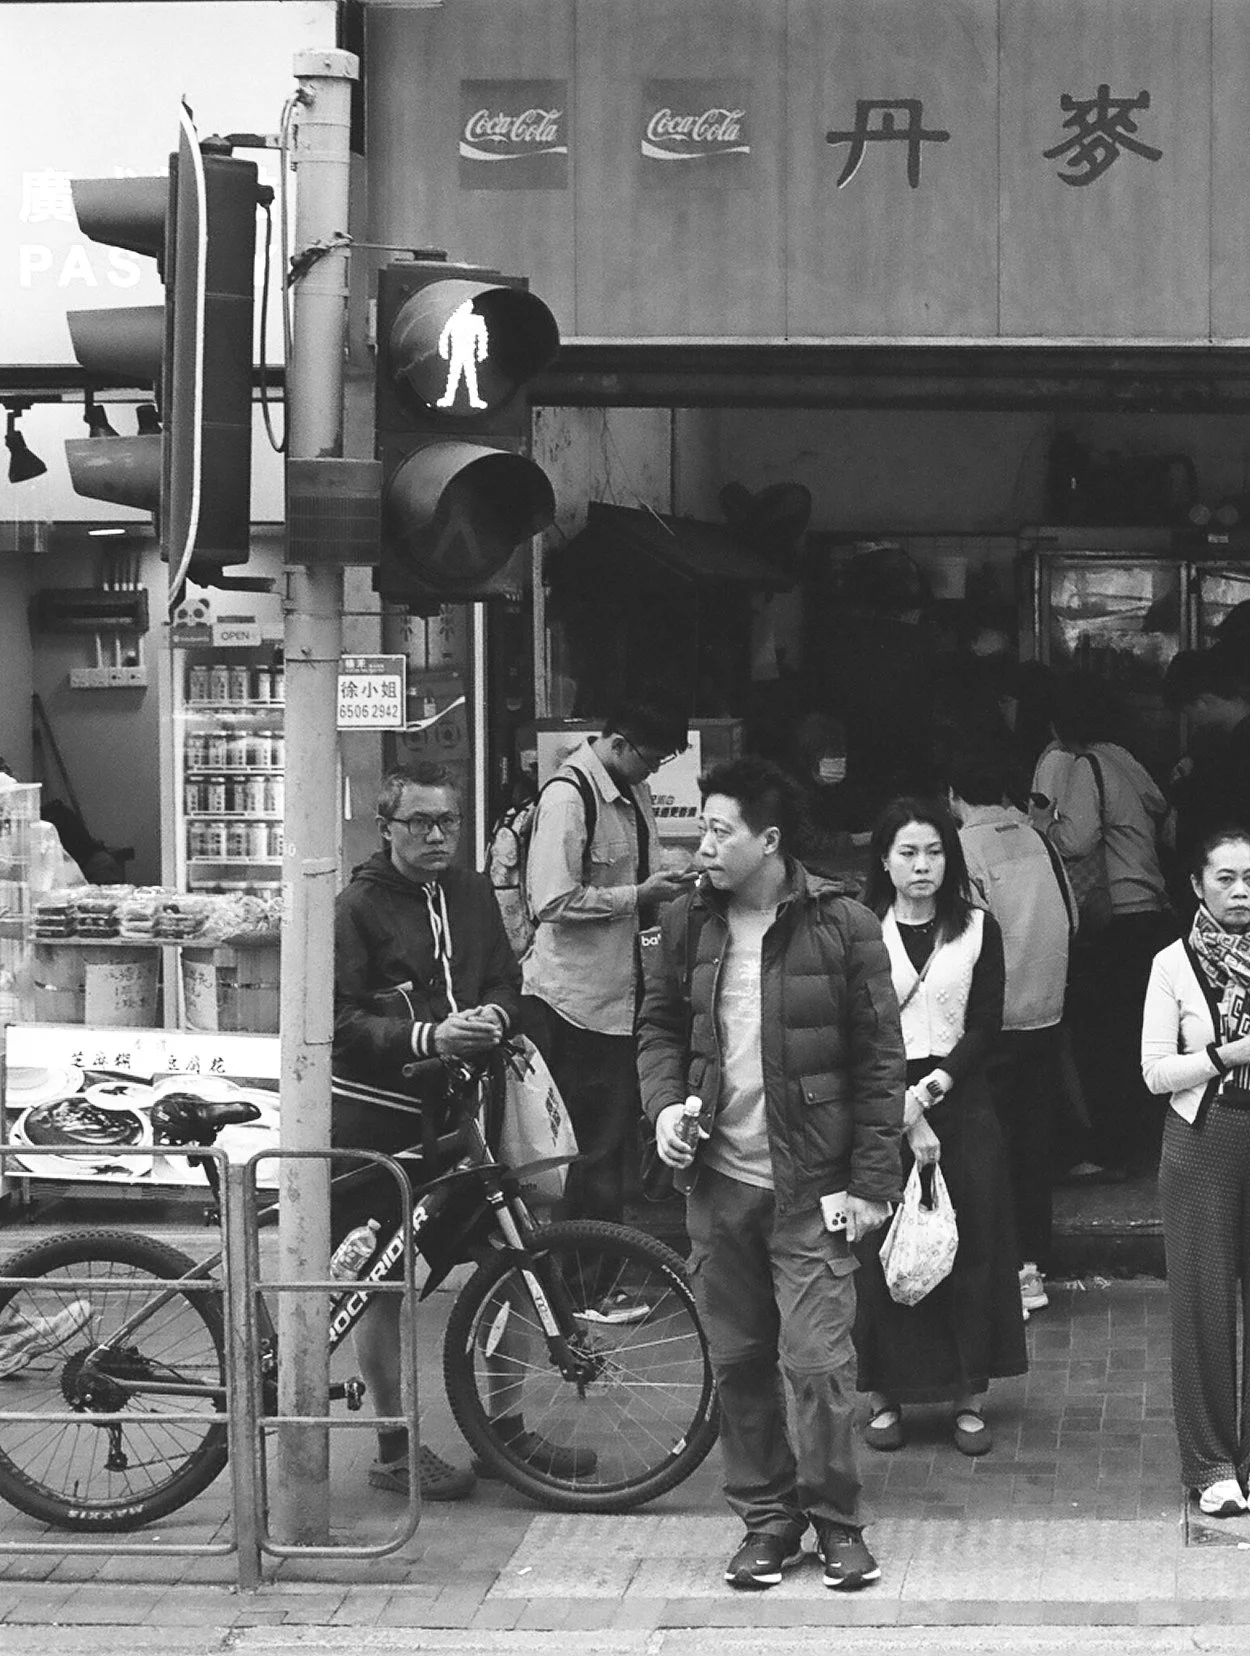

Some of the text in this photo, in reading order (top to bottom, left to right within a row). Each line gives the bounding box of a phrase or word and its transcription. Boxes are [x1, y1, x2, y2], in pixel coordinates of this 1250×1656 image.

[465, 109, 563, 142] Coca-Cola
[647, 109, 745, 142] Coca-Cola
[221, 631, 250, 641] OPEN
[340, 681, 397, 699] 徐小姐
